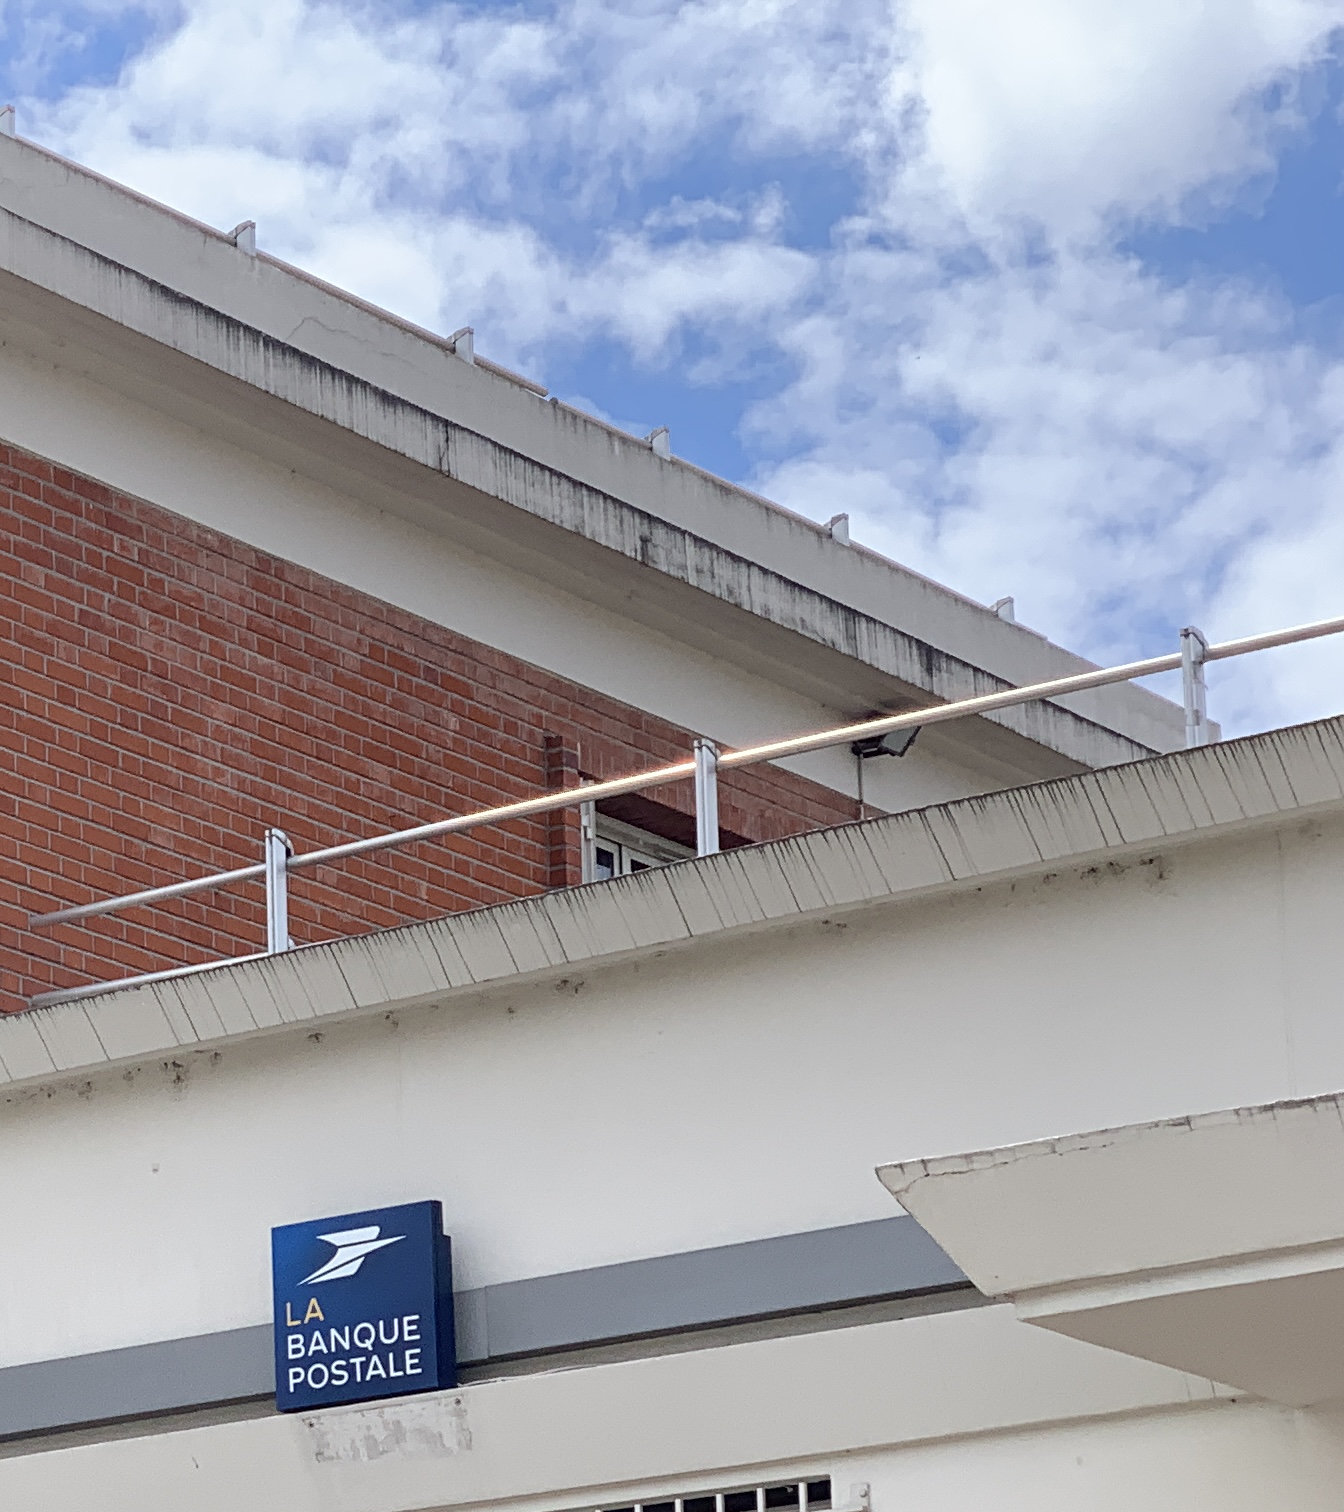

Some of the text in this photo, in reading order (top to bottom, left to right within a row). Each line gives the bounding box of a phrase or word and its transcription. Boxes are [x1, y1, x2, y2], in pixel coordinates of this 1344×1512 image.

[286, 1298, 324, 1327] LA
[287, 1314, 421, 1360] BANQUE
[288, 1348, 422, 1393] POSTALE
